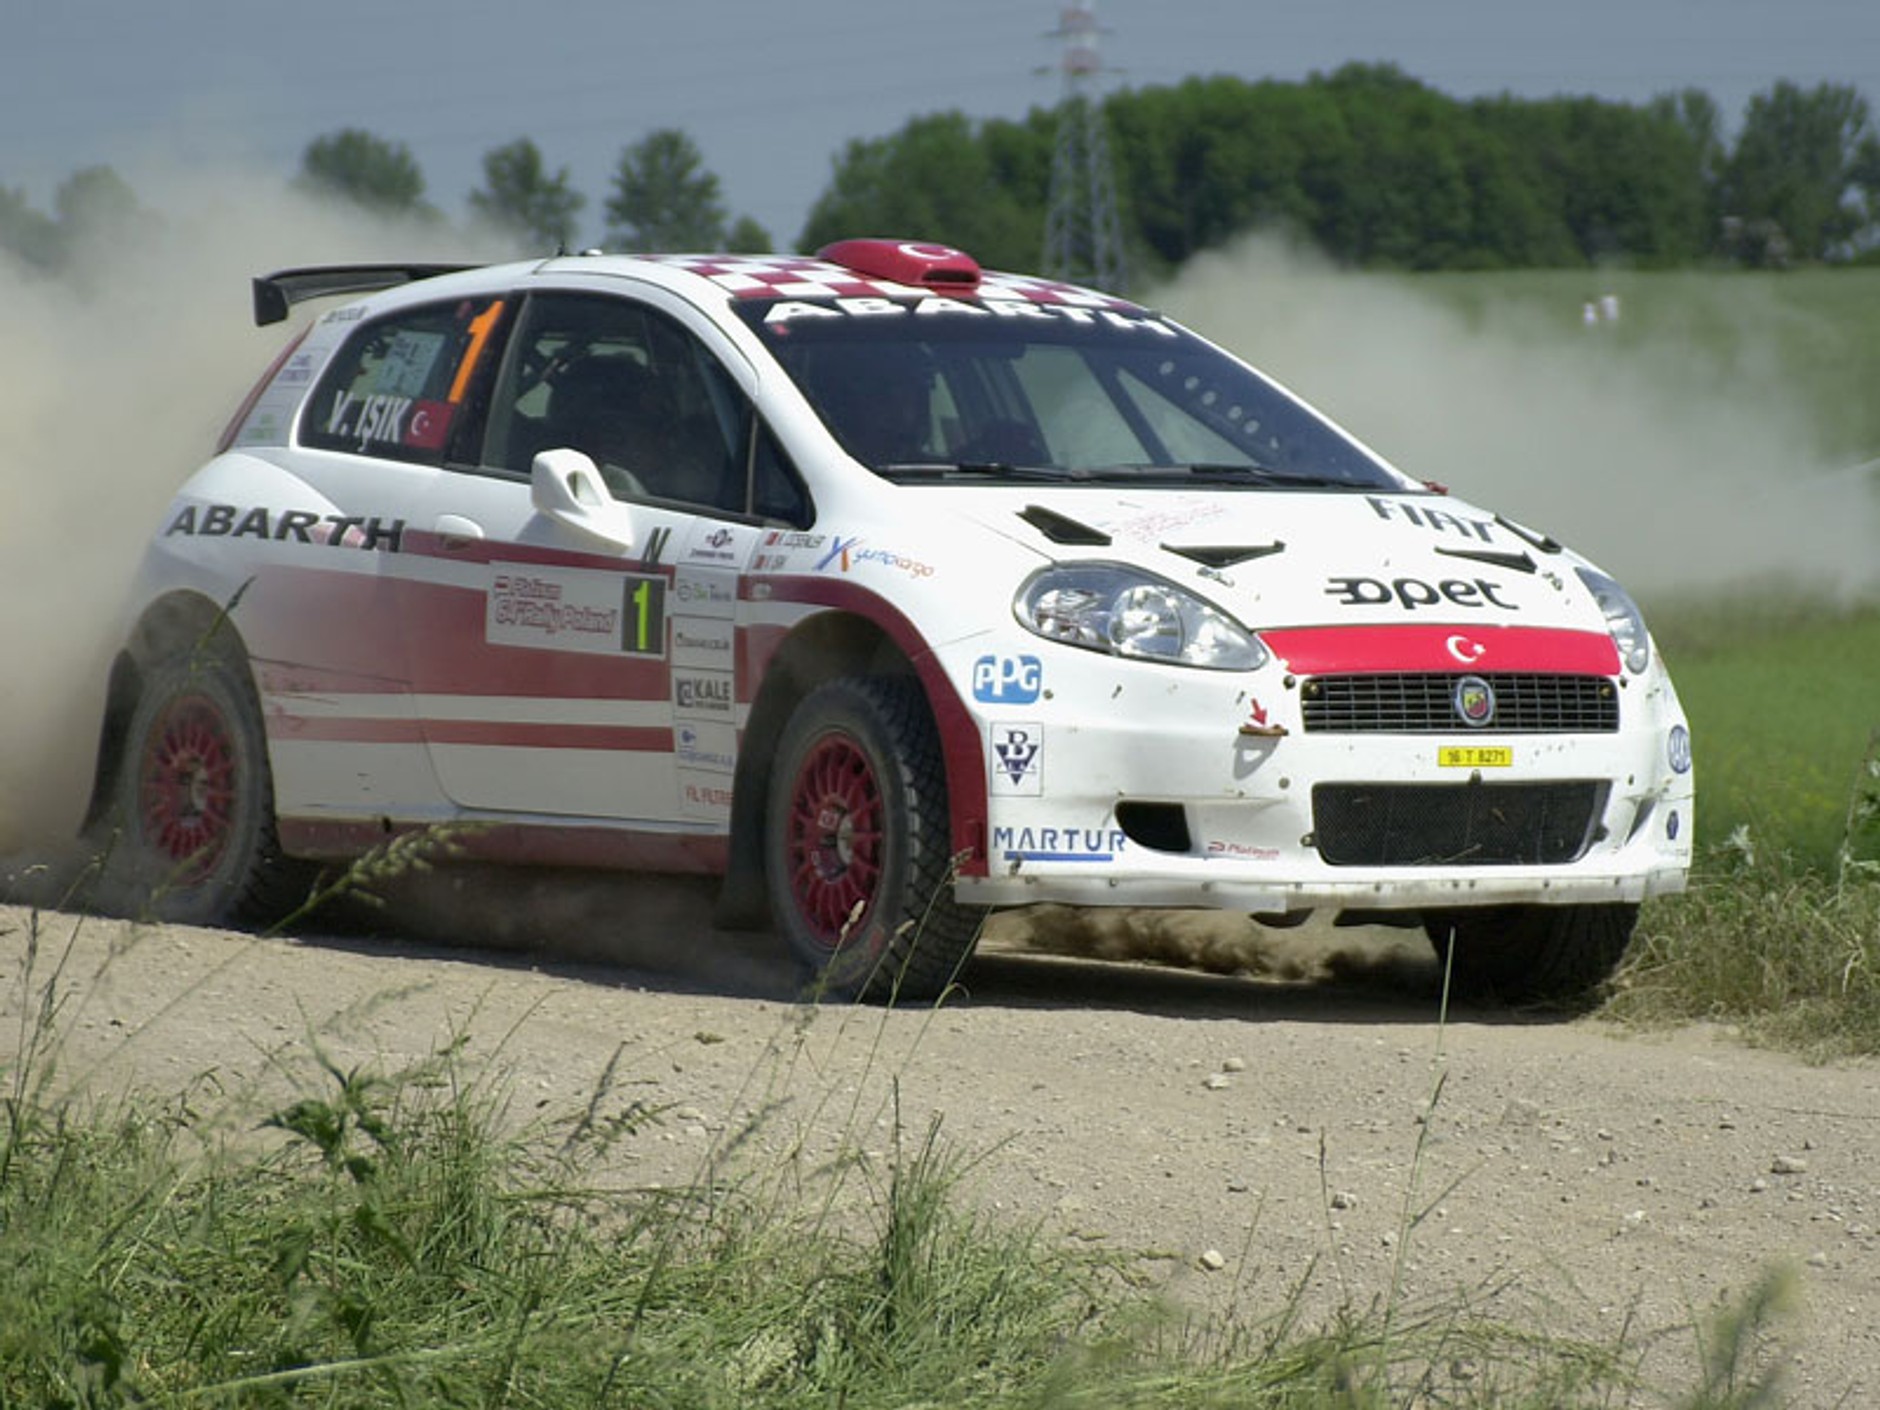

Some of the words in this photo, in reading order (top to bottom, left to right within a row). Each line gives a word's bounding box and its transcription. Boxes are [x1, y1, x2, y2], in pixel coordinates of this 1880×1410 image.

[762, 297, 1178, 338] ABARTH
[447, 301, 505, 404] 1
[165, 504, 406, 553] ABARTH
[1364, 496, 1496, 543] FIAT
[632, 580, 651, 650] 1
[693, 677, 731, 701] KALE
[974, 656, 1040, 696] PPG
[993, 826, 1127, 853] MARTUR
